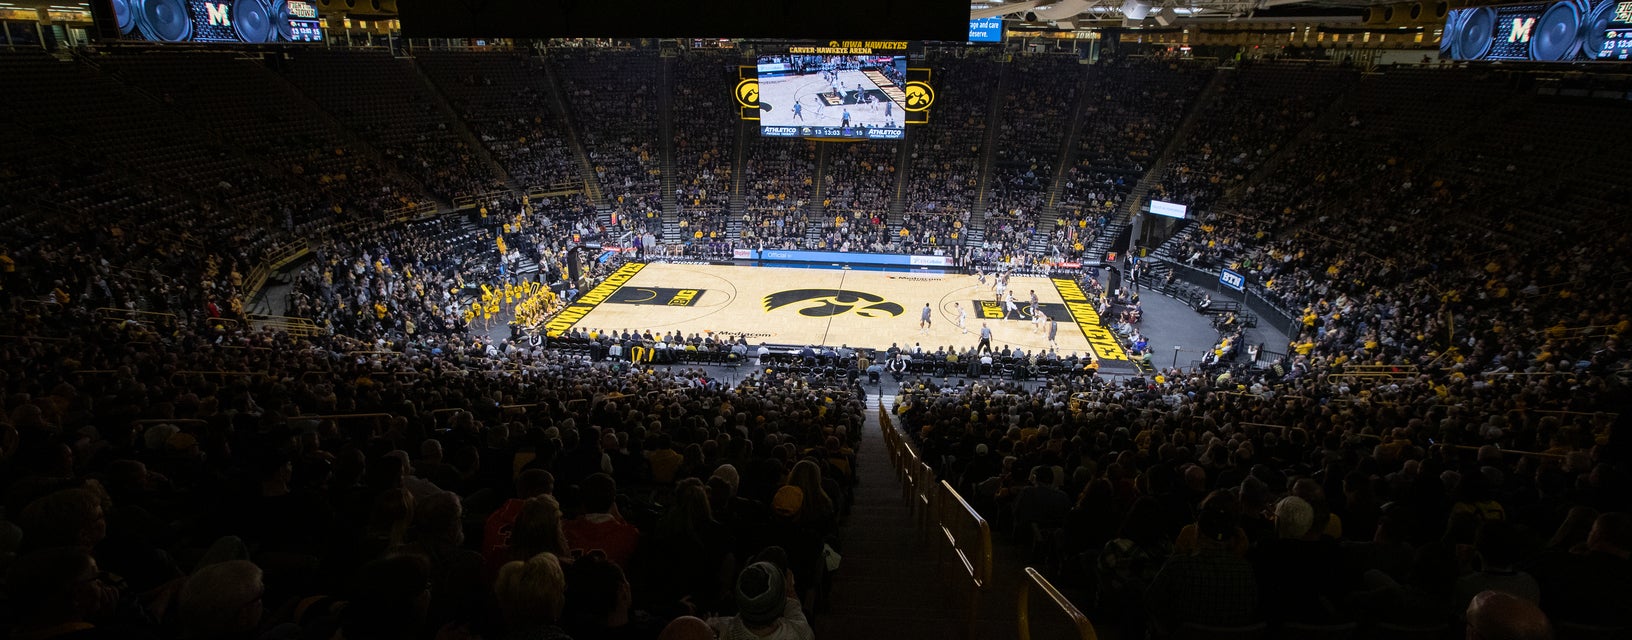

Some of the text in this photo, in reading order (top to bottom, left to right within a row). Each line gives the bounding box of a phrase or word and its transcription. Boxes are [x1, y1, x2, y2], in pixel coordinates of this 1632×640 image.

[205, 2, 230, 26] M
[980, 20, 988, 29] and
[1508, 17, 1535, 43] M
[865, 41, 908, 50] HAWKEYES
[1604, 40, 1616, 49] 13
[868, 128, 902, 136] ATHLETICO
[576, 262, 646, 305] HAWKEYES
[1222, 272, 1241, 286] BTN
[1052, 278, 1087, 300] IOWA
[1066, 302, 1129, 360] HAWKEYES
